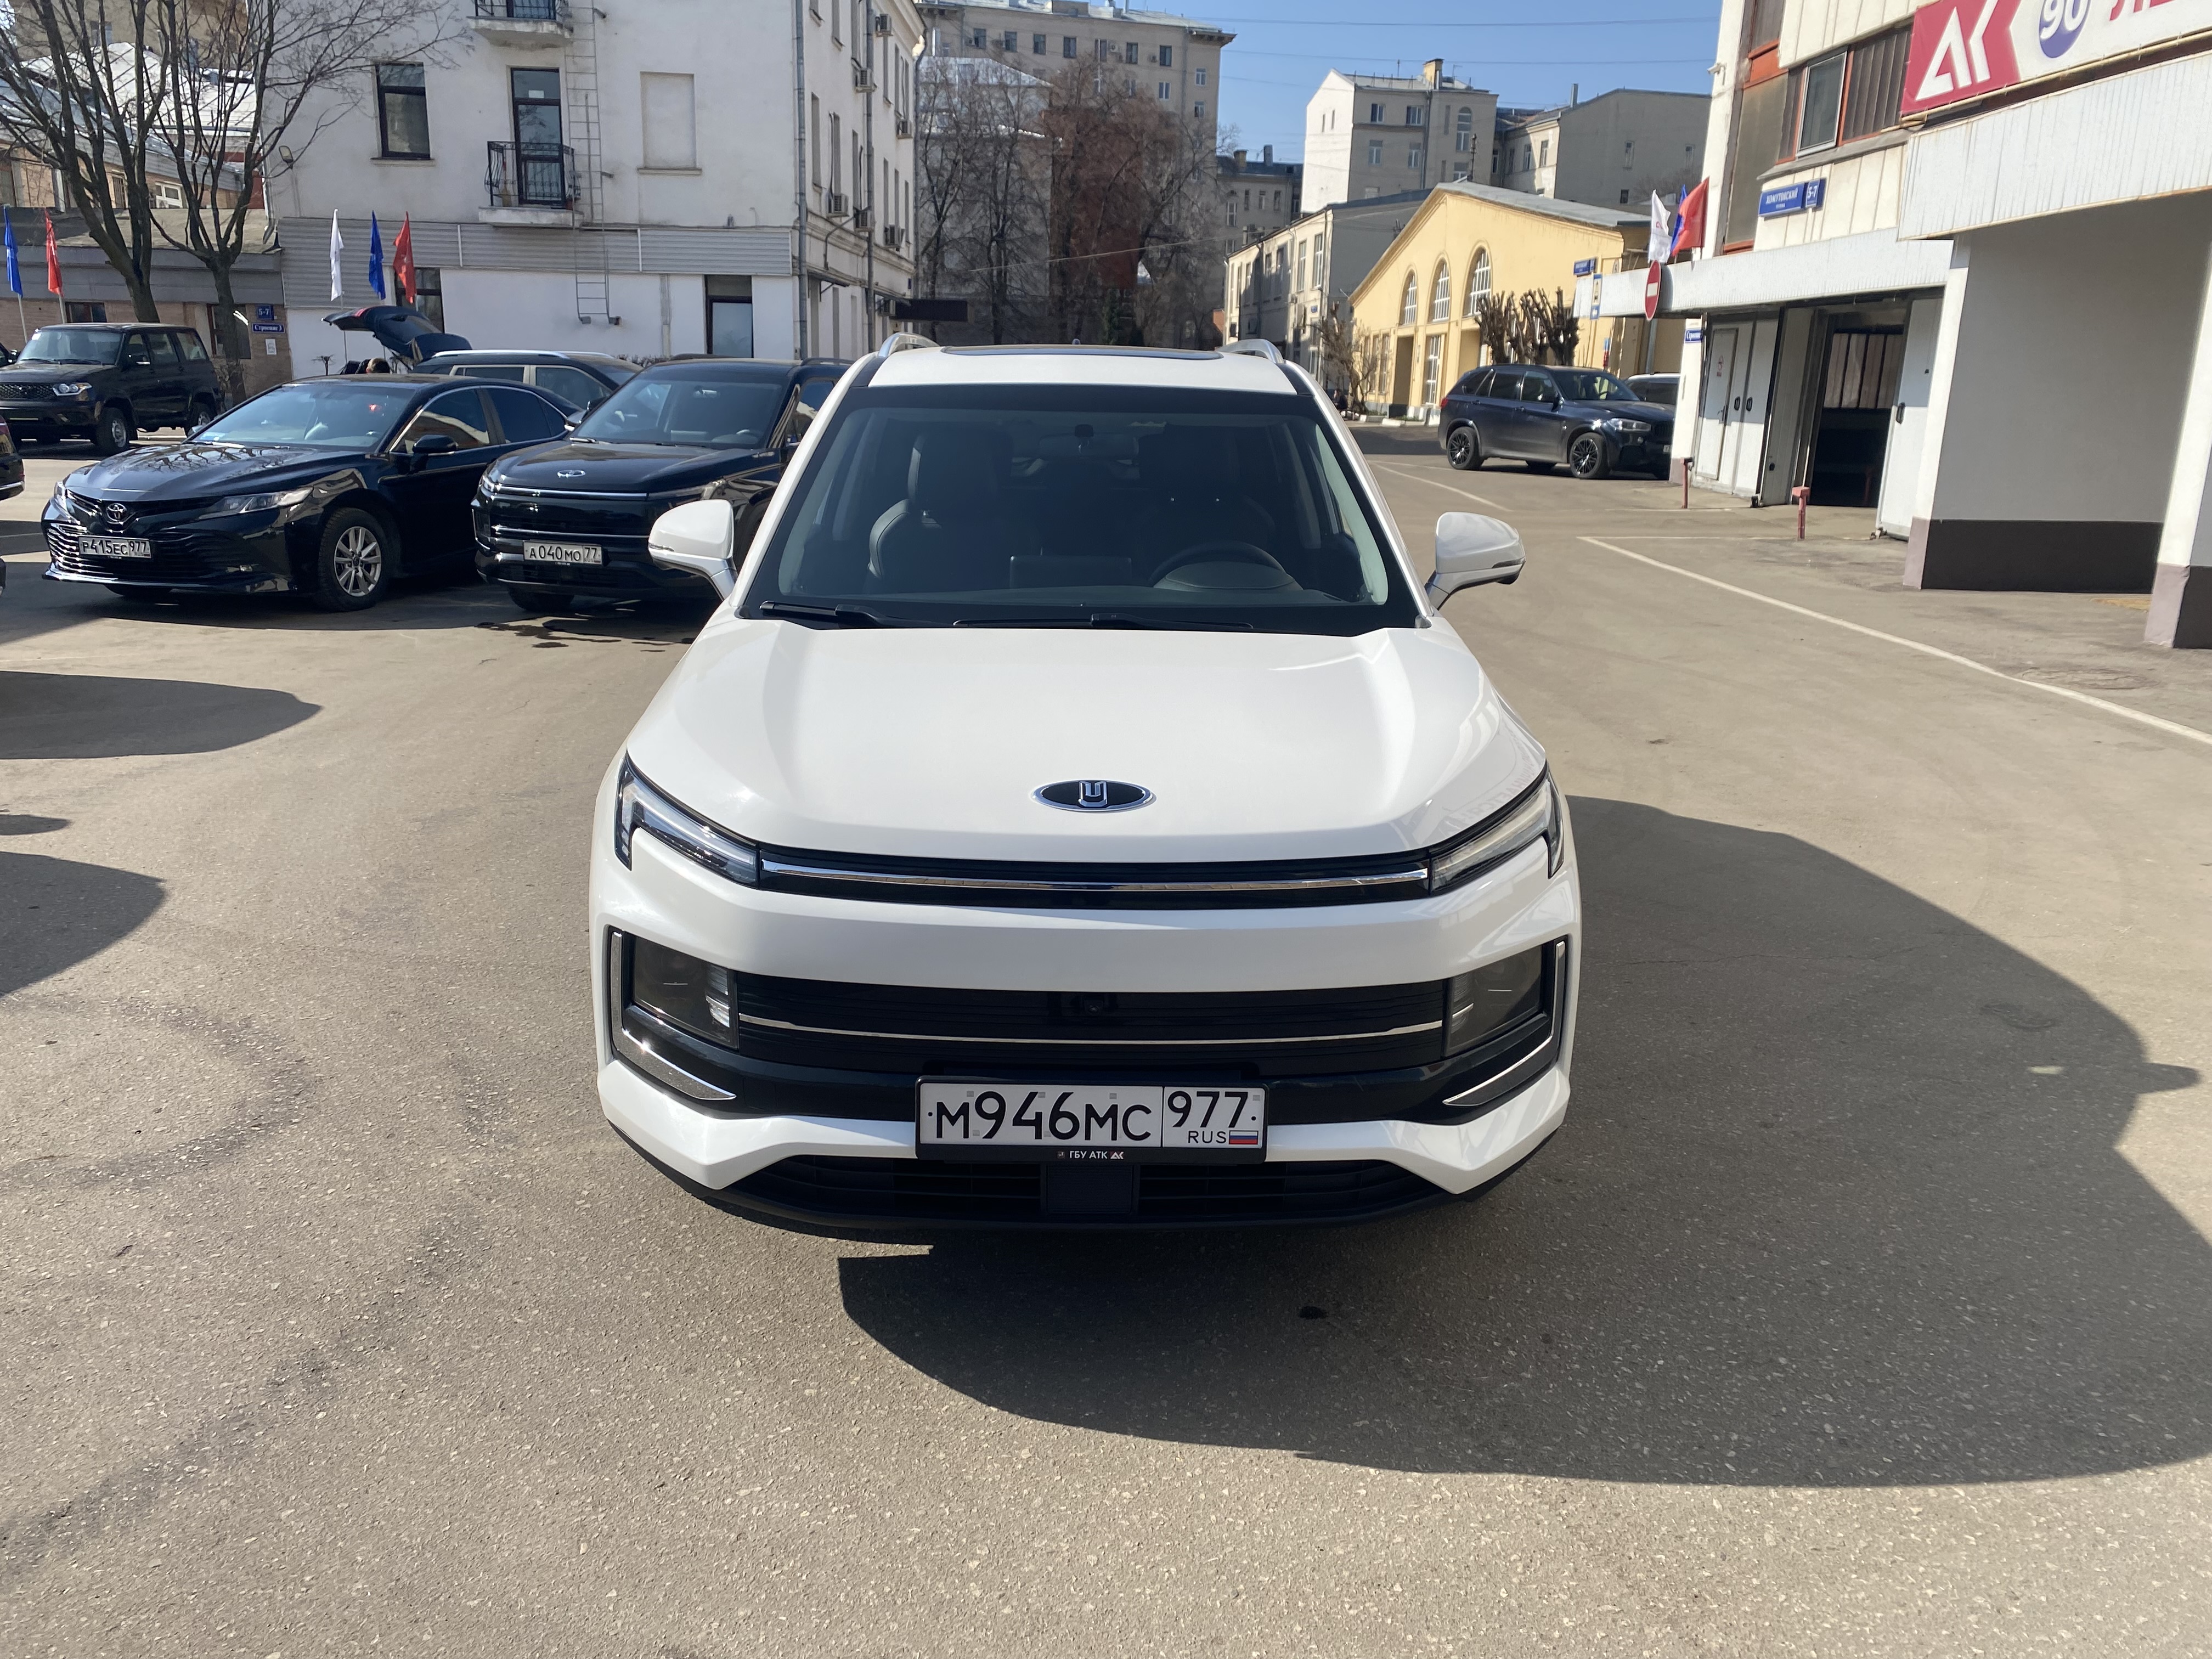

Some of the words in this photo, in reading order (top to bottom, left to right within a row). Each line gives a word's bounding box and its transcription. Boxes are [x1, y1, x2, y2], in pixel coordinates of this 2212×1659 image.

[82, 539, 128, 555] Р415ЕС
[129, 541, 146, 552] 977
[529, 545, 581, 561] А040МО
[584, 548, 597, 558] 77
[936, 1091, 1152, 1141] М946МС
[1167, 1091, 1249, 1128] 977
[1188, 1131, 1227, 1144] RUS
[1089, 1151, 1108, 1159] АТК
